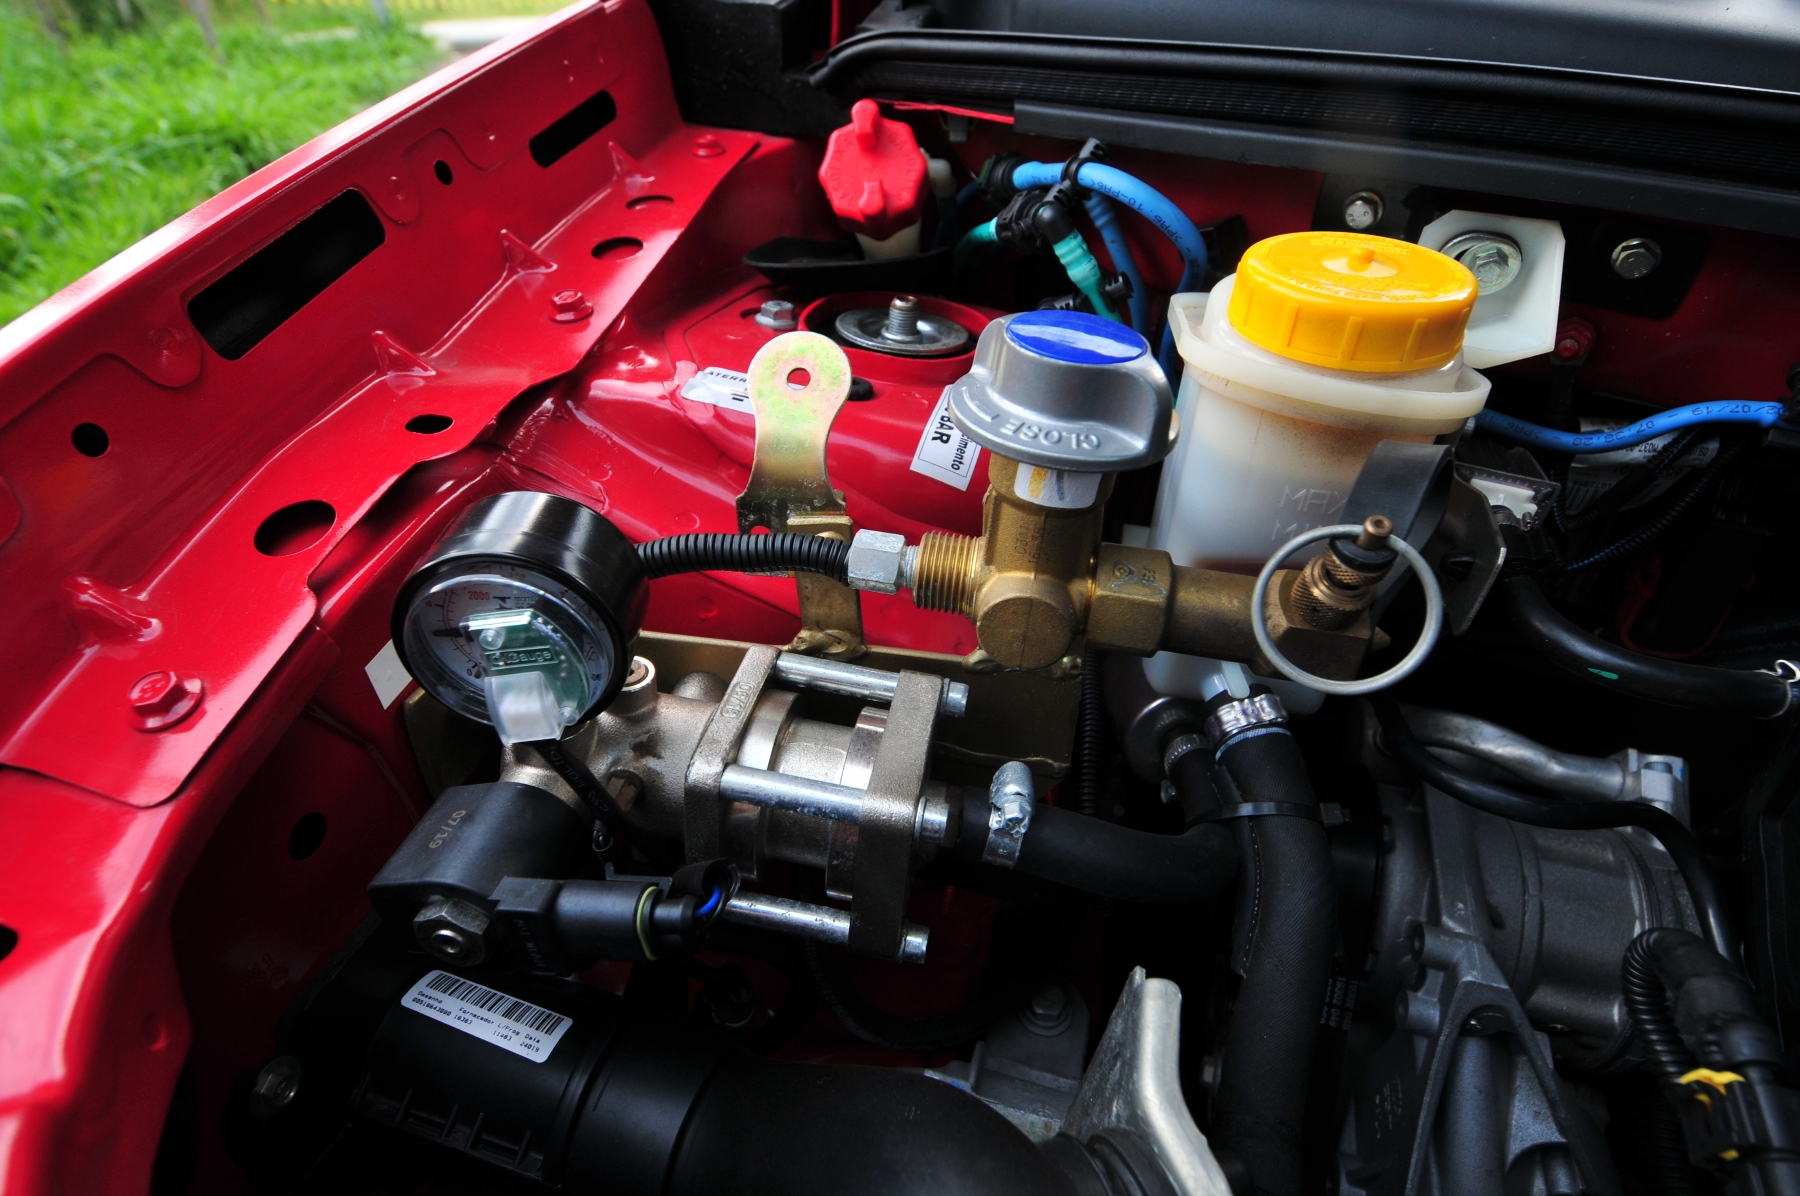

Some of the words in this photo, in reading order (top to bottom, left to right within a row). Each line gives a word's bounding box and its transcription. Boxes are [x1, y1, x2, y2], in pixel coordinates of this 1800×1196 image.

[998, 417, 1102, 451] CLOSE
[1278, 485, 1350, 515] MAX
[467, 590, 490, 602] 2000
[428, 808, 467, 850] 07/19
[417, 991, 443, 1004] Desenho
[458, 1007, 495, 1025] Fornecedor
[524, 1033, 541, 1044] Data
